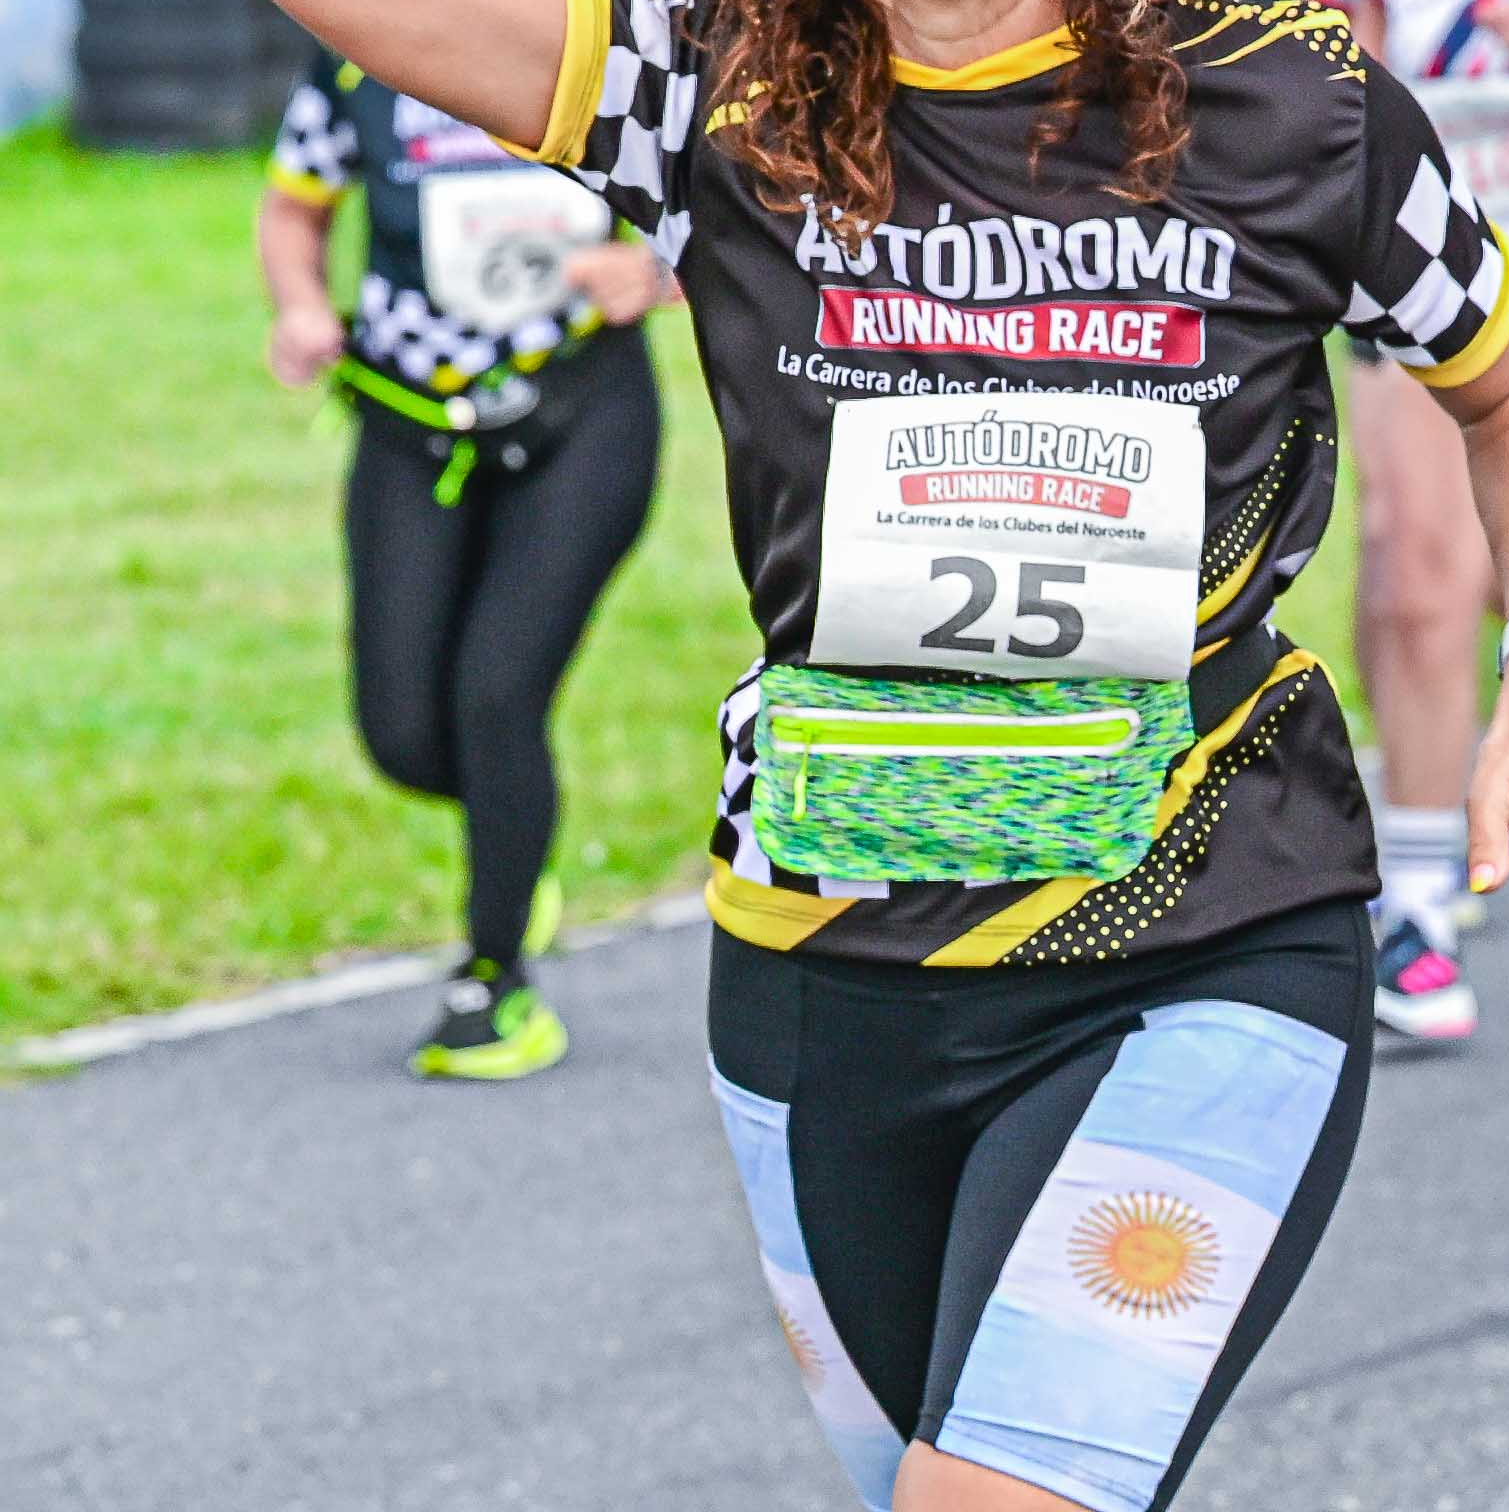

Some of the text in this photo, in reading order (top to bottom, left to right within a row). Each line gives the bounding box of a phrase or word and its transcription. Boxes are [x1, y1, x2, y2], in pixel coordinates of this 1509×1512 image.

[850, 297, 1169, 361] RUNNING RACE
[777, 344, 802, 377] La
[805, 353, 892, 394] Carrera
[897, 368, 933, 395] de
[937, 372, 977, 394] los
[1131, 372, 1241, 403] Noroeste
[886, 409, 1152, 483] AUTÓDROMO
[925, 475, 1106, 513] RUNNING RACE
[876, 510, 1147, 541] La Carrera de los Clubes del Noroeste
[919, 555, 1087, 659] 25
